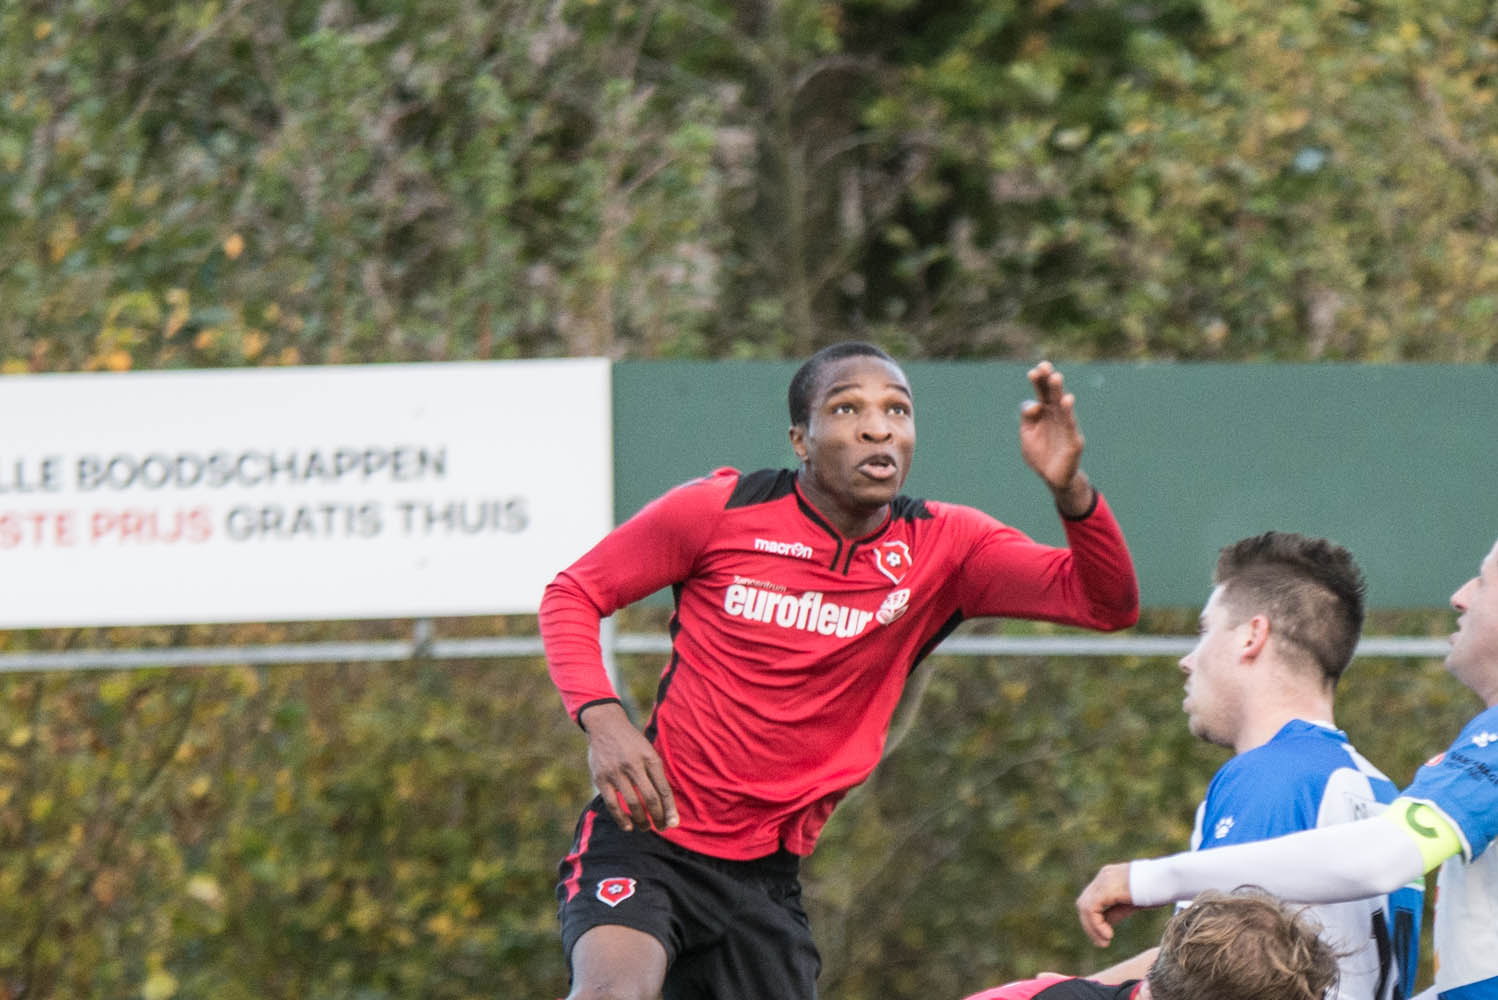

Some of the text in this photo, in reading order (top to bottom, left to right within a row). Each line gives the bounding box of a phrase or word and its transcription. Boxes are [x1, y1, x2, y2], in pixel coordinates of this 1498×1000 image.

[0, 445, 447, 493] LE BOODSCHAPPEN
[91, 505, 213, 543] PRIJS
[225, 501, 382, 541] GRATIS
[399, 497, 529, 536] THUIS
[754, 537, 813, 559] macron
[723, 583, 874, 639] eurofleur
